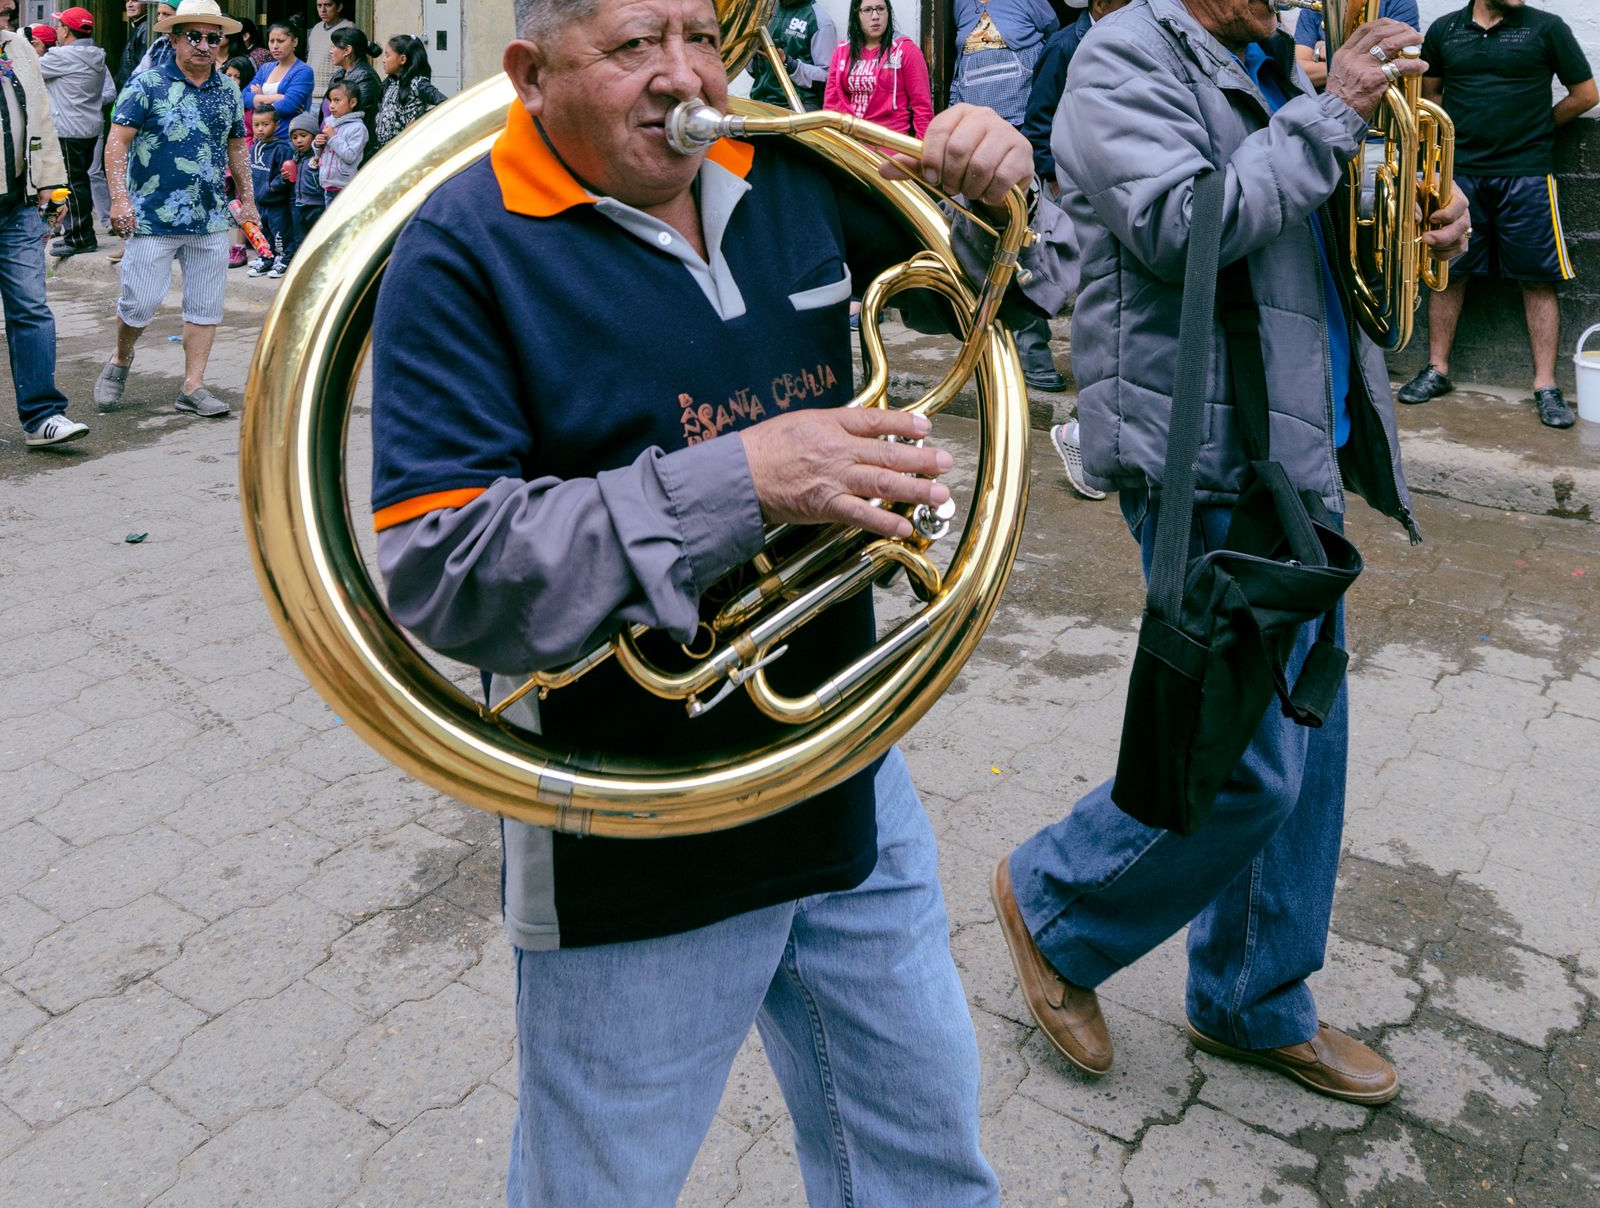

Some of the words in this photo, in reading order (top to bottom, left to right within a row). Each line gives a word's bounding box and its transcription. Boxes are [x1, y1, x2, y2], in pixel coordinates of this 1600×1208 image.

[789, 17, 808, 34] 94
[697, 387, 767, 441] SANTA
[771, 364, 838, 409] CECILIA
